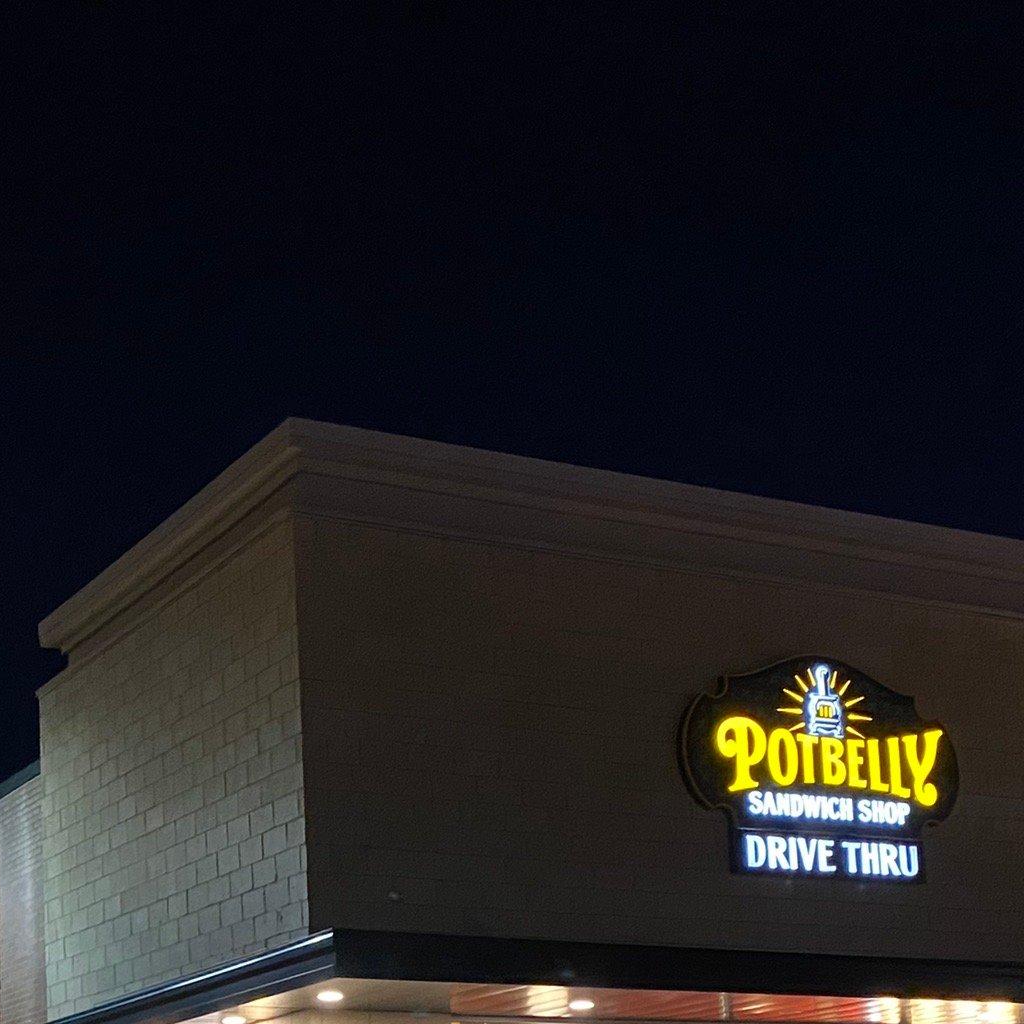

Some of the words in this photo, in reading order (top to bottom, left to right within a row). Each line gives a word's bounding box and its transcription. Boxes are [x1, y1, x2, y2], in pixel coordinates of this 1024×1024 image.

[716, 716, 943, 806] POTBELLY
[748, 791, 854, 822] SANDWICH
[857, 799, 911, 826] SHOP
[745, 834, 836, 872] DRIVE
[842, 841, 919, 877] THRU
